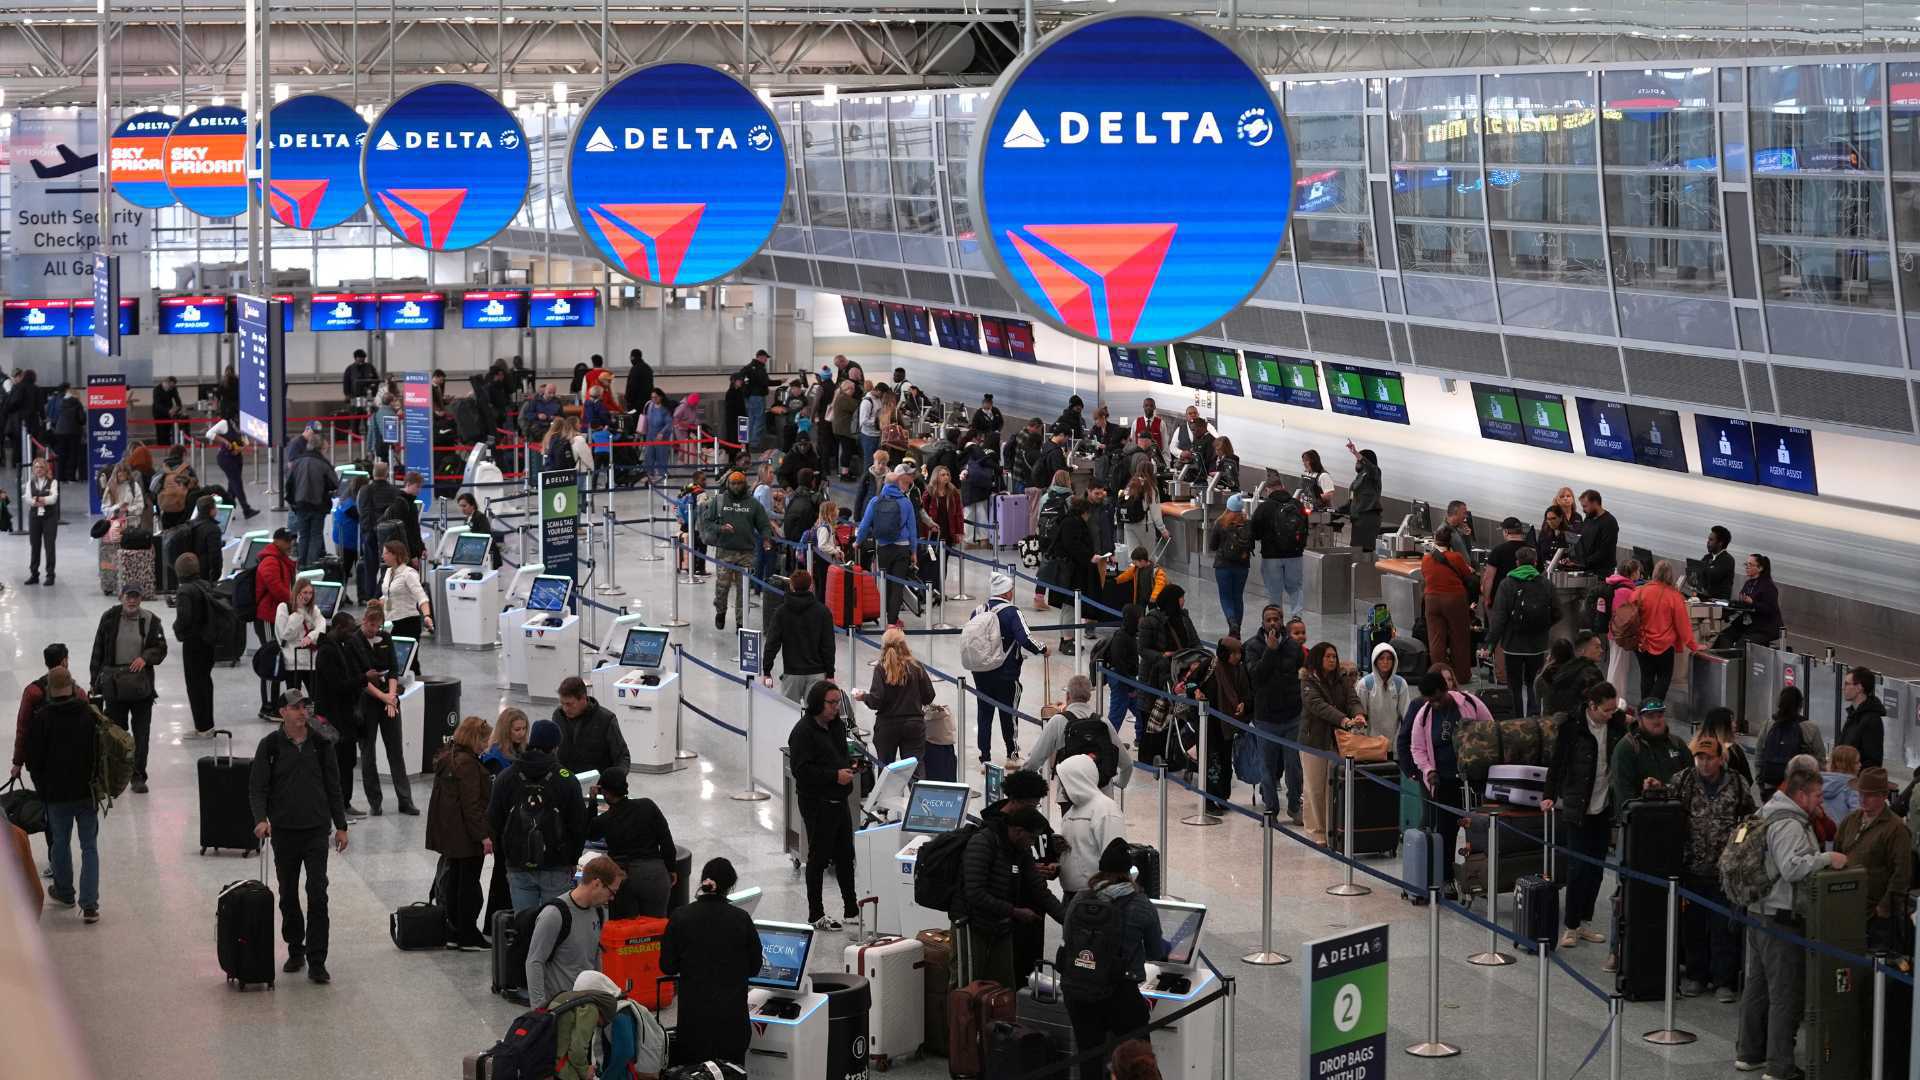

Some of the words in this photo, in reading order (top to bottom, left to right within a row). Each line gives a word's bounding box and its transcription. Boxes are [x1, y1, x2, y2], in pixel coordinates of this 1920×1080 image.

[137, 122, 170, 130] DELTA
[201, 117, 239, 126] DELTA
[1060, 111, 1223, 144] DELTA
[279, 133, 350, 148] DELTA
[405, 131, 493, 149] DELTA
[625, 127, 738, 150] DELTA
[112, 147, 144, 160] SKY
[171, 147, 208, 161] SKY
[112, 159, 163, 171] PRIOR
[171, 159, 244, 174] PRIORIT
[18, 209, 67, 225] South
[73, 208, 143, 227] Secrity
[34, 231, 128, 250] Checkpnt
[43, 260, 67, 276] All
[104, 416, 110, 425] 2
[1594, 438, 1608, 448] AGENT
[1712, 457, 1727, 467] AGENT
[1728, 460, 1743, 470] ASSIST
[551, 475, 569, 483] DELTA
[1769, 466, 1785, 476] AGENT
[1786, 468, 1802, 479] ASSIST
[547, 520, 560, 529] SCAN
[548, 528, 560, 536] YOUR
[946, 800, 954, 808] IN
[762, 944, 784, 954] HECK
[785, 946, 793, 956] IN
[1331, 941, 1370, 963] DELTA
[1341, 993, 1353, 1023] 2
[1320, 1054, 1347, 1075] DROP
[1347, 1046, 1374, 1066] BAGS
[1355, 1066, 1366, 1080] ID
